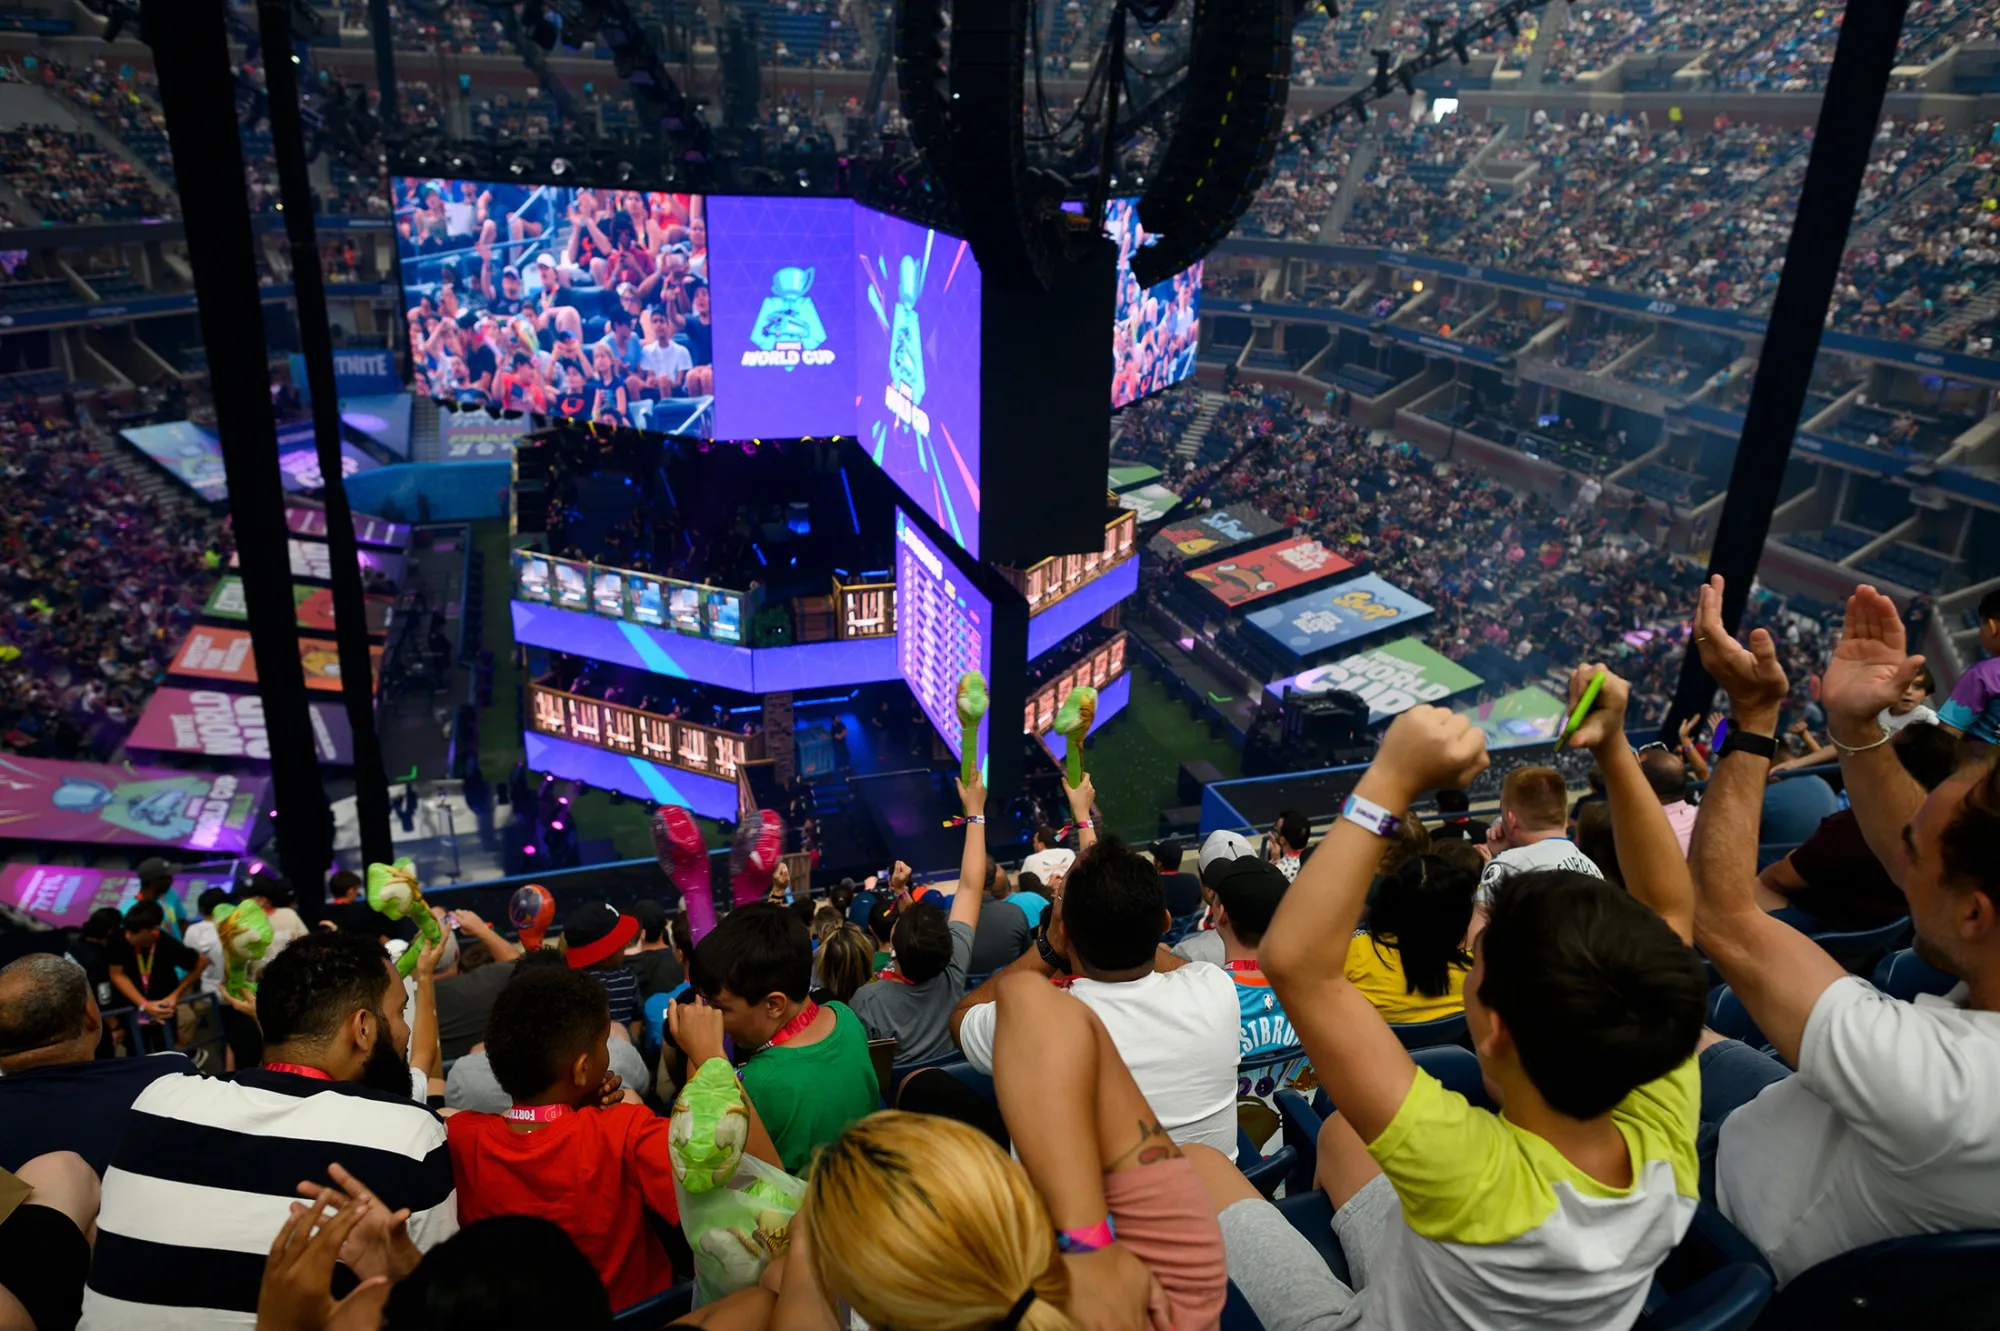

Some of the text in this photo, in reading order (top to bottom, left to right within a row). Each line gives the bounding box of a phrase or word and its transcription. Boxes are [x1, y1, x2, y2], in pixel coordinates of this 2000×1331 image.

[336, 354, 387, 376] TNITE
[741, 350, 836, 366] WORLD CUP
[1294, 664, 1417, 716] CUP
[1339, 654, 1451, 701] WORLD
[189, 690, 245, 756] WORLD
